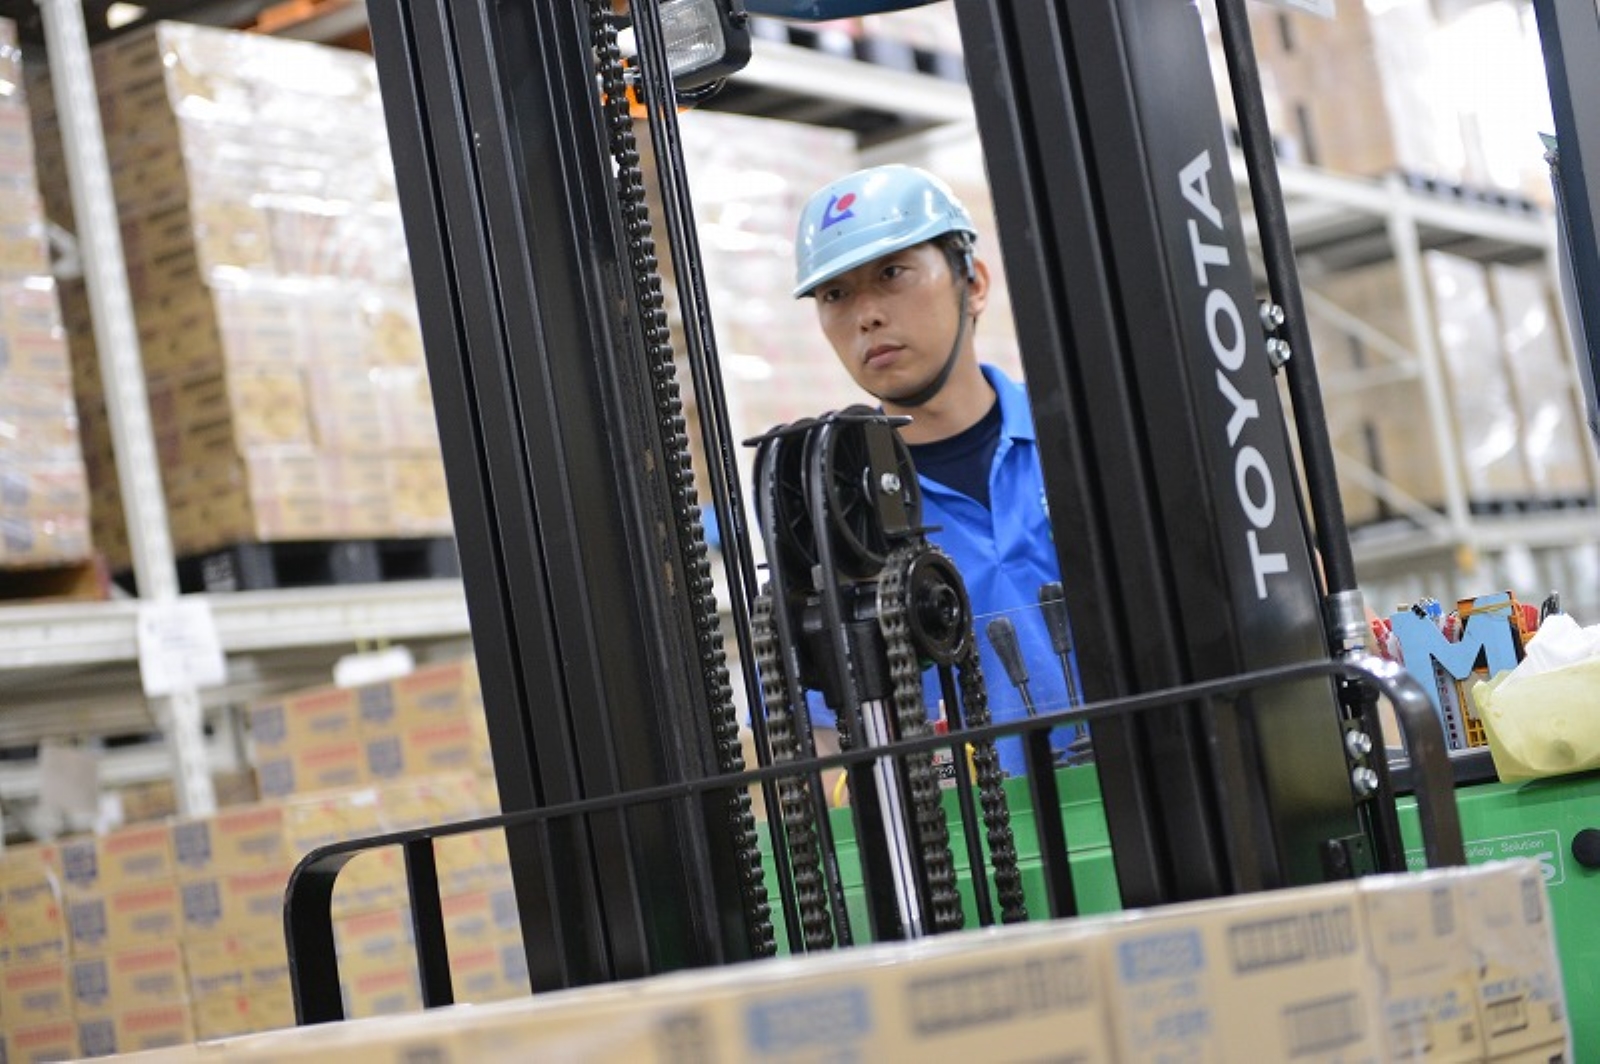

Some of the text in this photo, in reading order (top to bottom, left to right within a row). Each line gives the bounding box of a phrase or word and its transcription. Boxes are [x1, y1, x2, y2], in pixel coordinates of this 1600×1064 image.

[1178, 149, 1289, 599] TOYOTA
[1464, 839, 1544, 858] afety Solution
